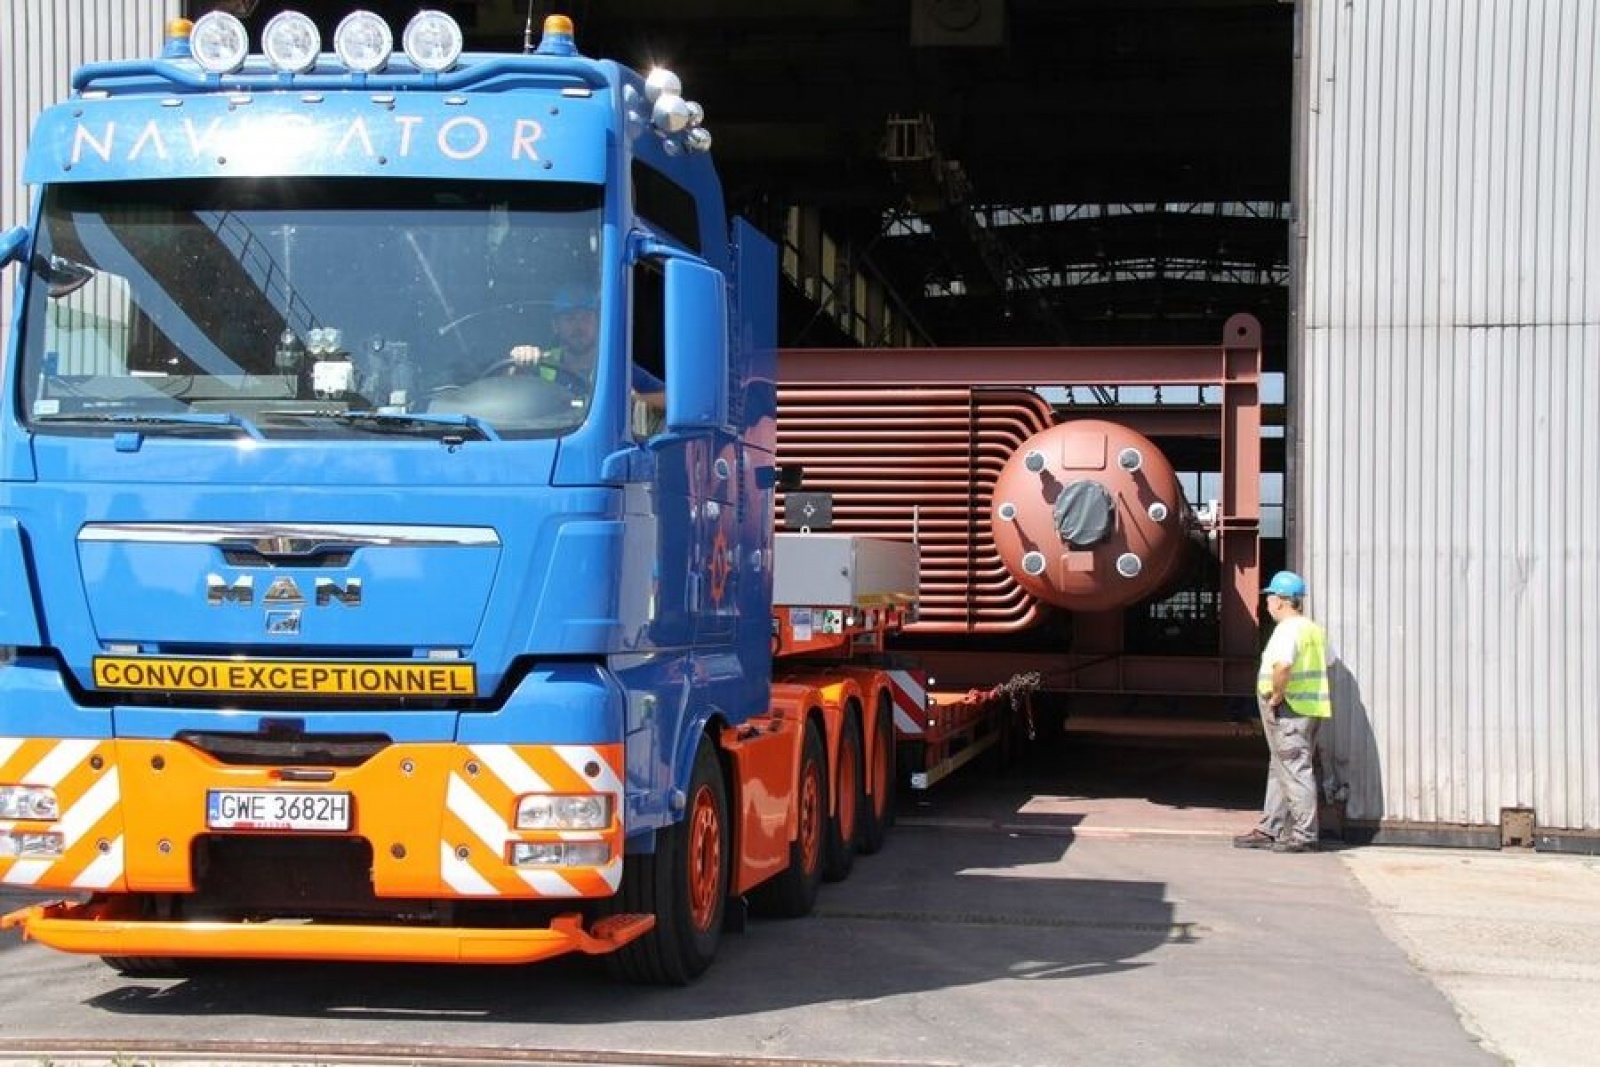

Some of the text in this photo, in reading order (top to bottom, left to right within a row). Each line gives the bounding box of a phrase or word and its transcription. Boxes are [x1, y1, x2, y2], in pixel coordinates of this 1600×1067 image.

[71, 115, 543, 163] NAVATOR
[206, 573, 362, 608] MAN
[102, 662, 468, 692] CONVOI EXCEPTIONNEL
[221, 794, 266, 820] GWE
[274, 796, 346, 821] 3682H
